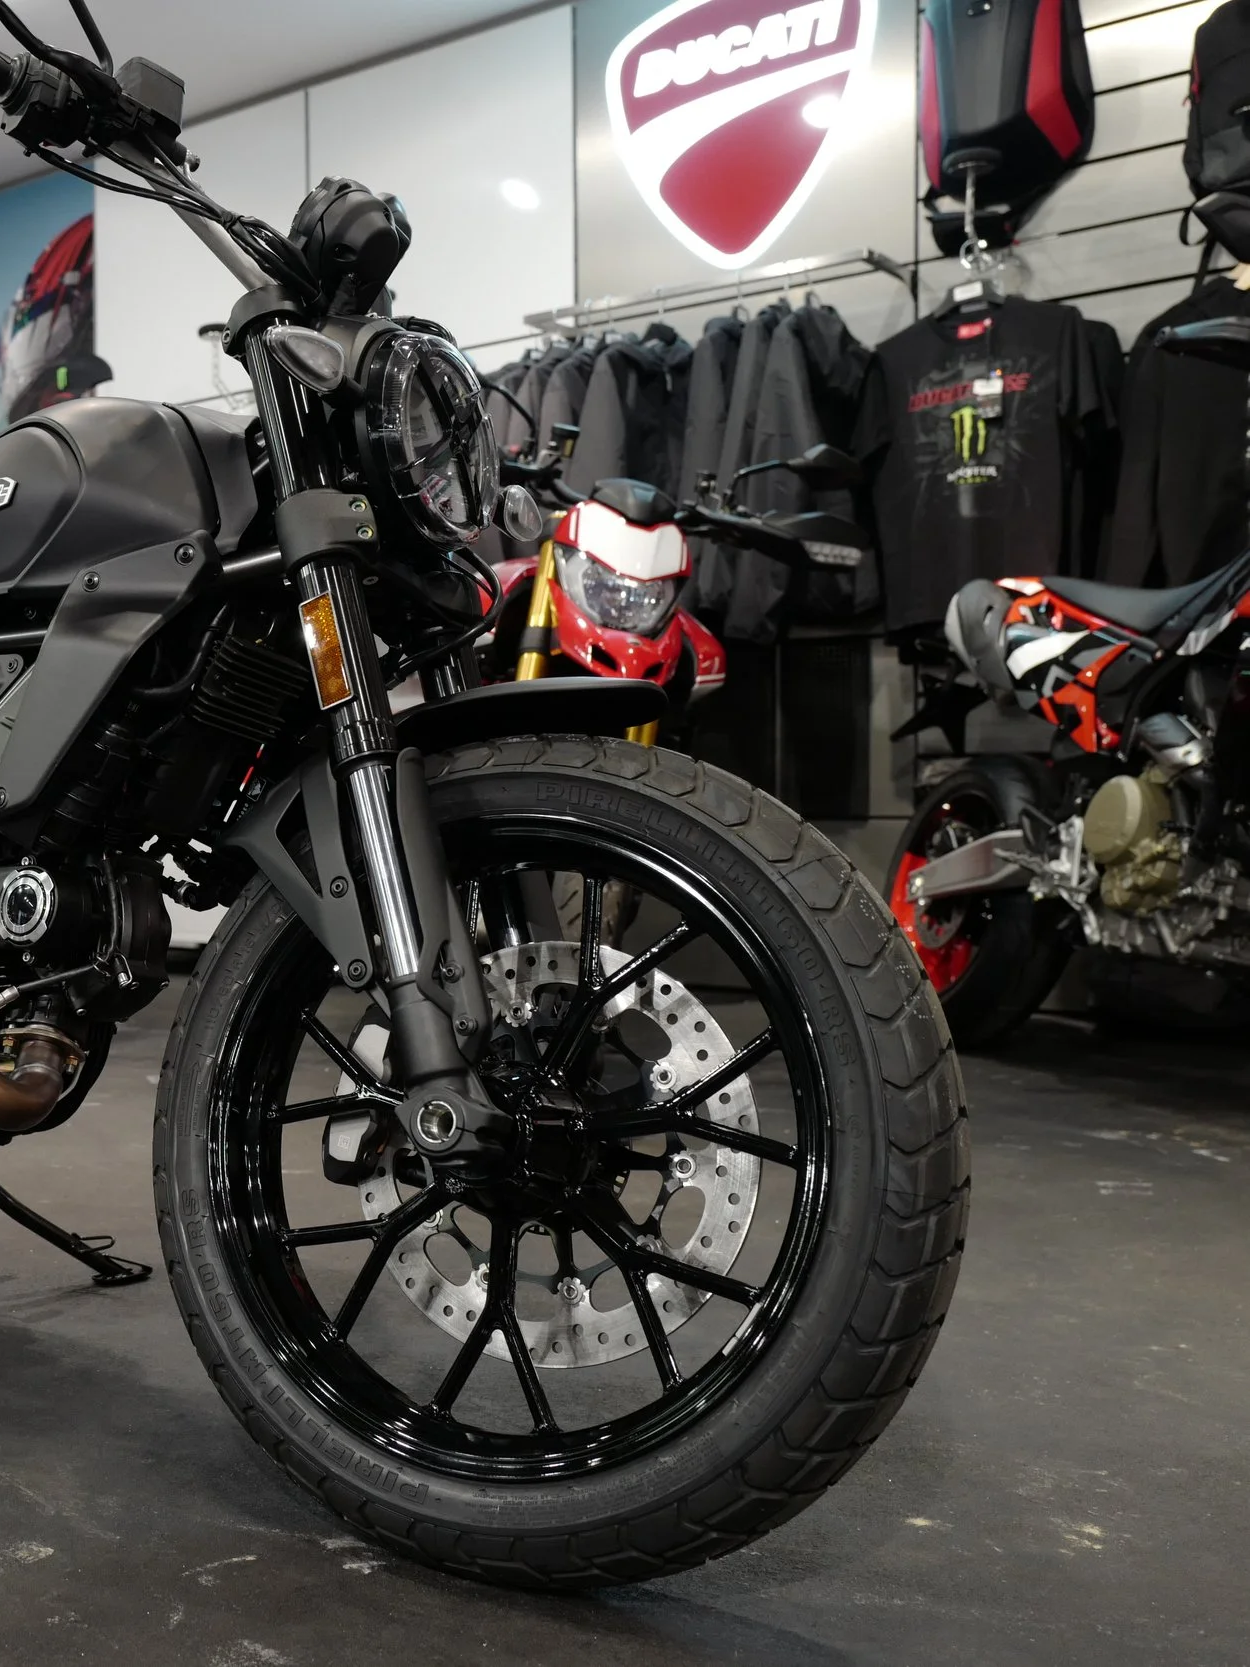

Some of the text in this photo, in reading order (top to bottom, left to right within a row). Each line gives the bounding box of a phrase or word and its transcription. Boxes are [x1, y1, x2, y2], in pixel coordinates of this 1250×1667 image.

[633, 0, 844, 98] DUCATI
[536, 781, 719, 862] PIRELLI
[262, 1385, 430, 1507] PIRELLI
